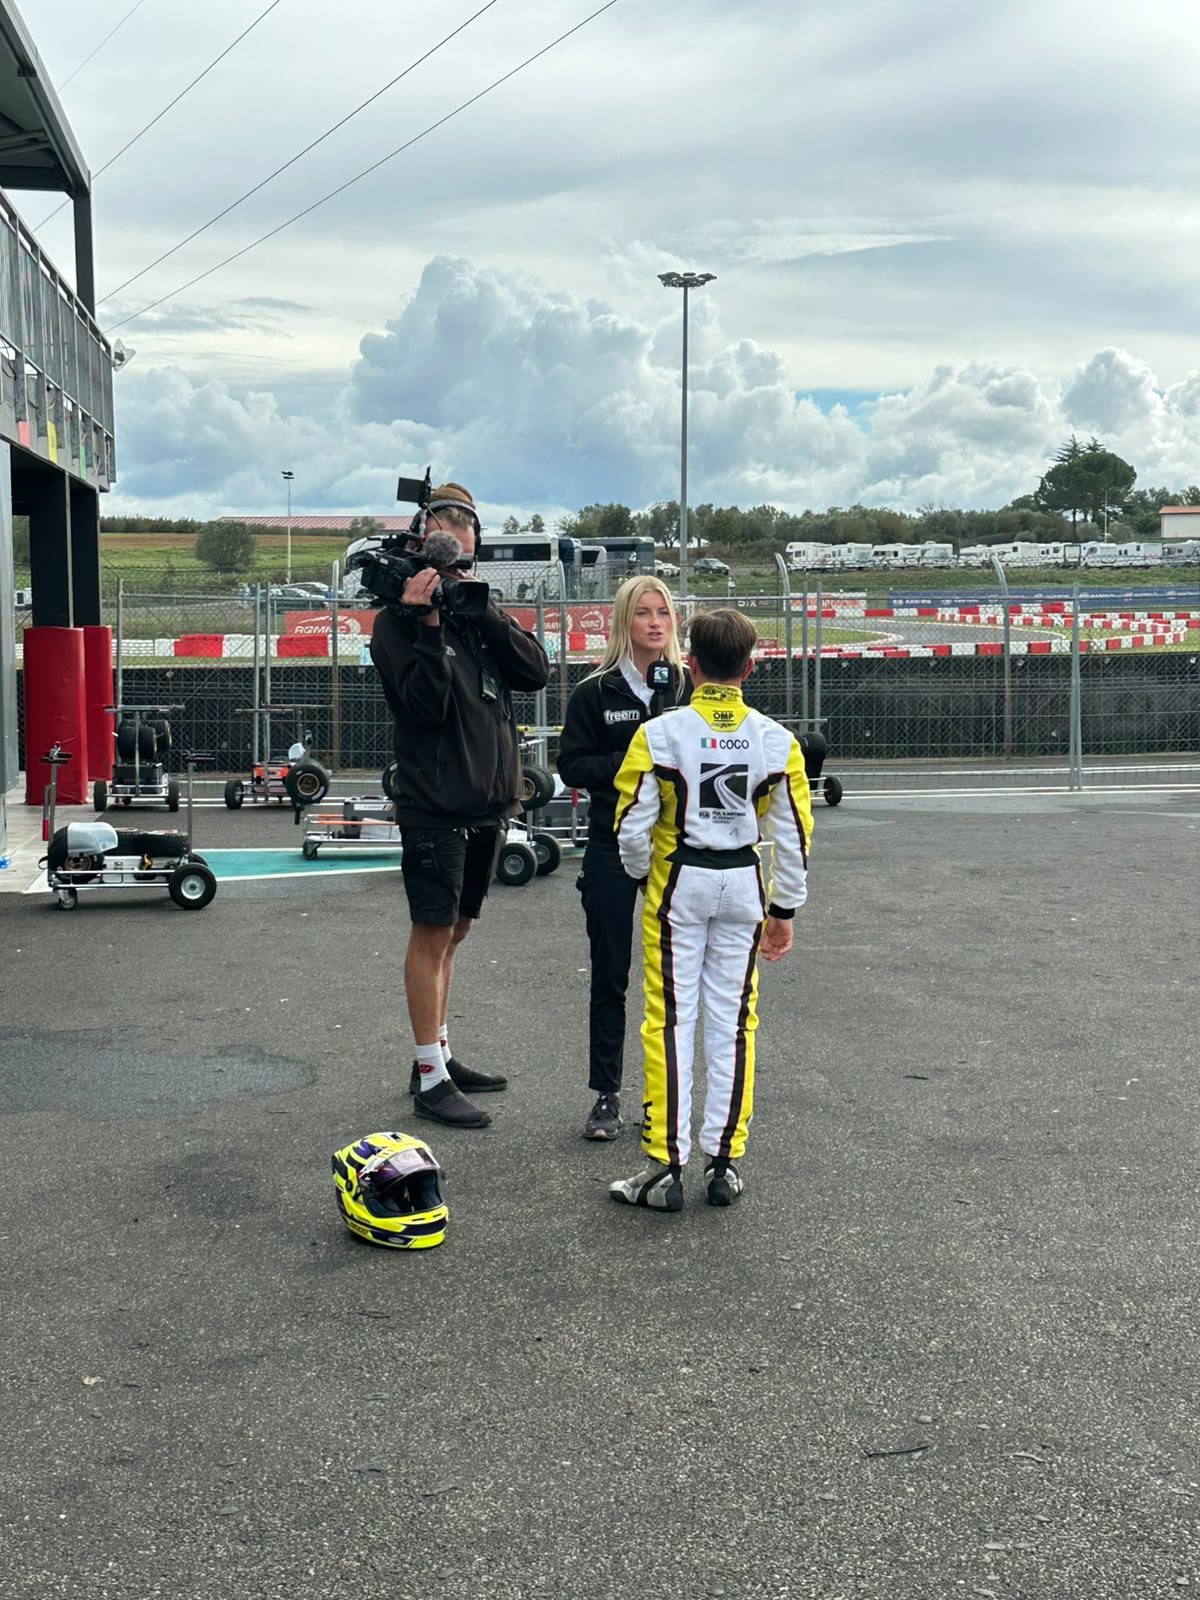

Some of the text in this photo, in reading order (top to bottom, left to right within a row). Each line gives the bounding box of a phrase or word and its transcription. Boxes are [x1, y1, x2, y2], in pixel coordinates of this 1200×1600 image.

[604, 709, 640, 725] freem
[713, 712, 734, 720] OMP
[719, 739, 750, 750] COCO
